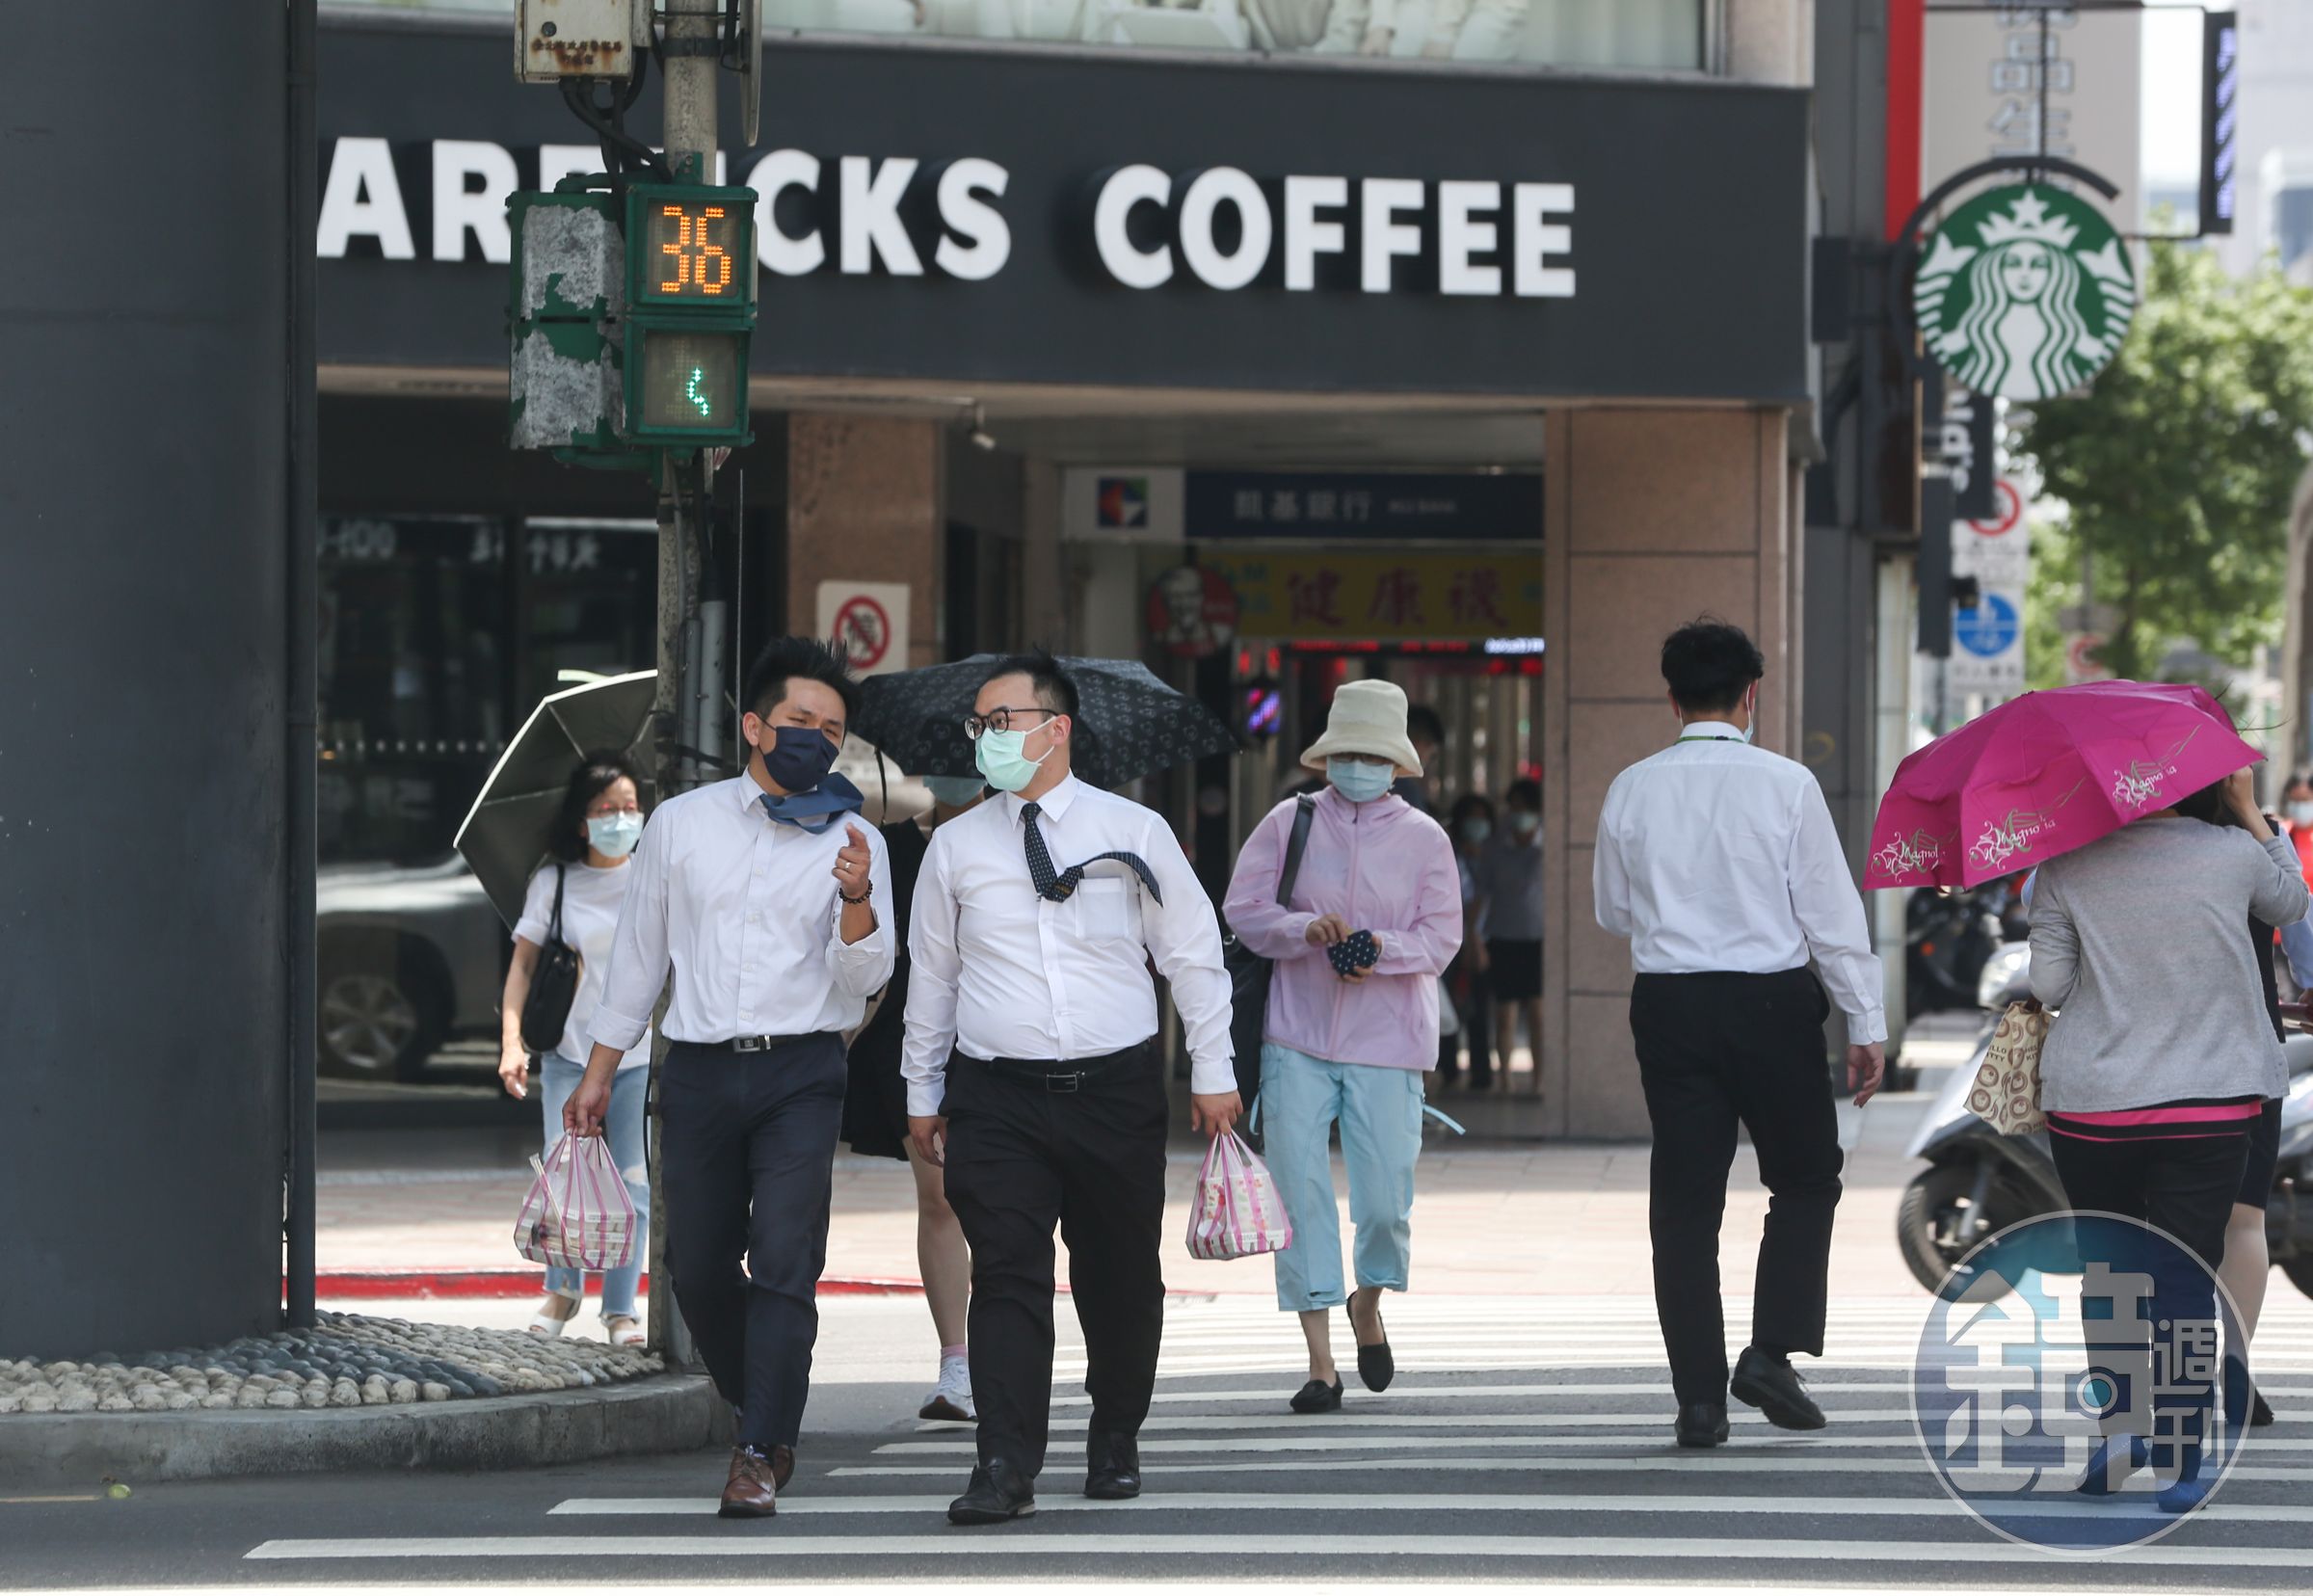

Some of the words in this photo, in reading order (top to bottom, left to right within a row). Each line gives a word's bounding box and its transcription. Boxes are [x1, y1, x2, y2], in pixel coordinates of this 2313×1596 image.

[1987, 2, 2078, 189] 品生
[317, 137, 1011, 281] ARCKS
[1094, 164, 1576, 298] COFFEE
[662, 205, 731, 294] 36
